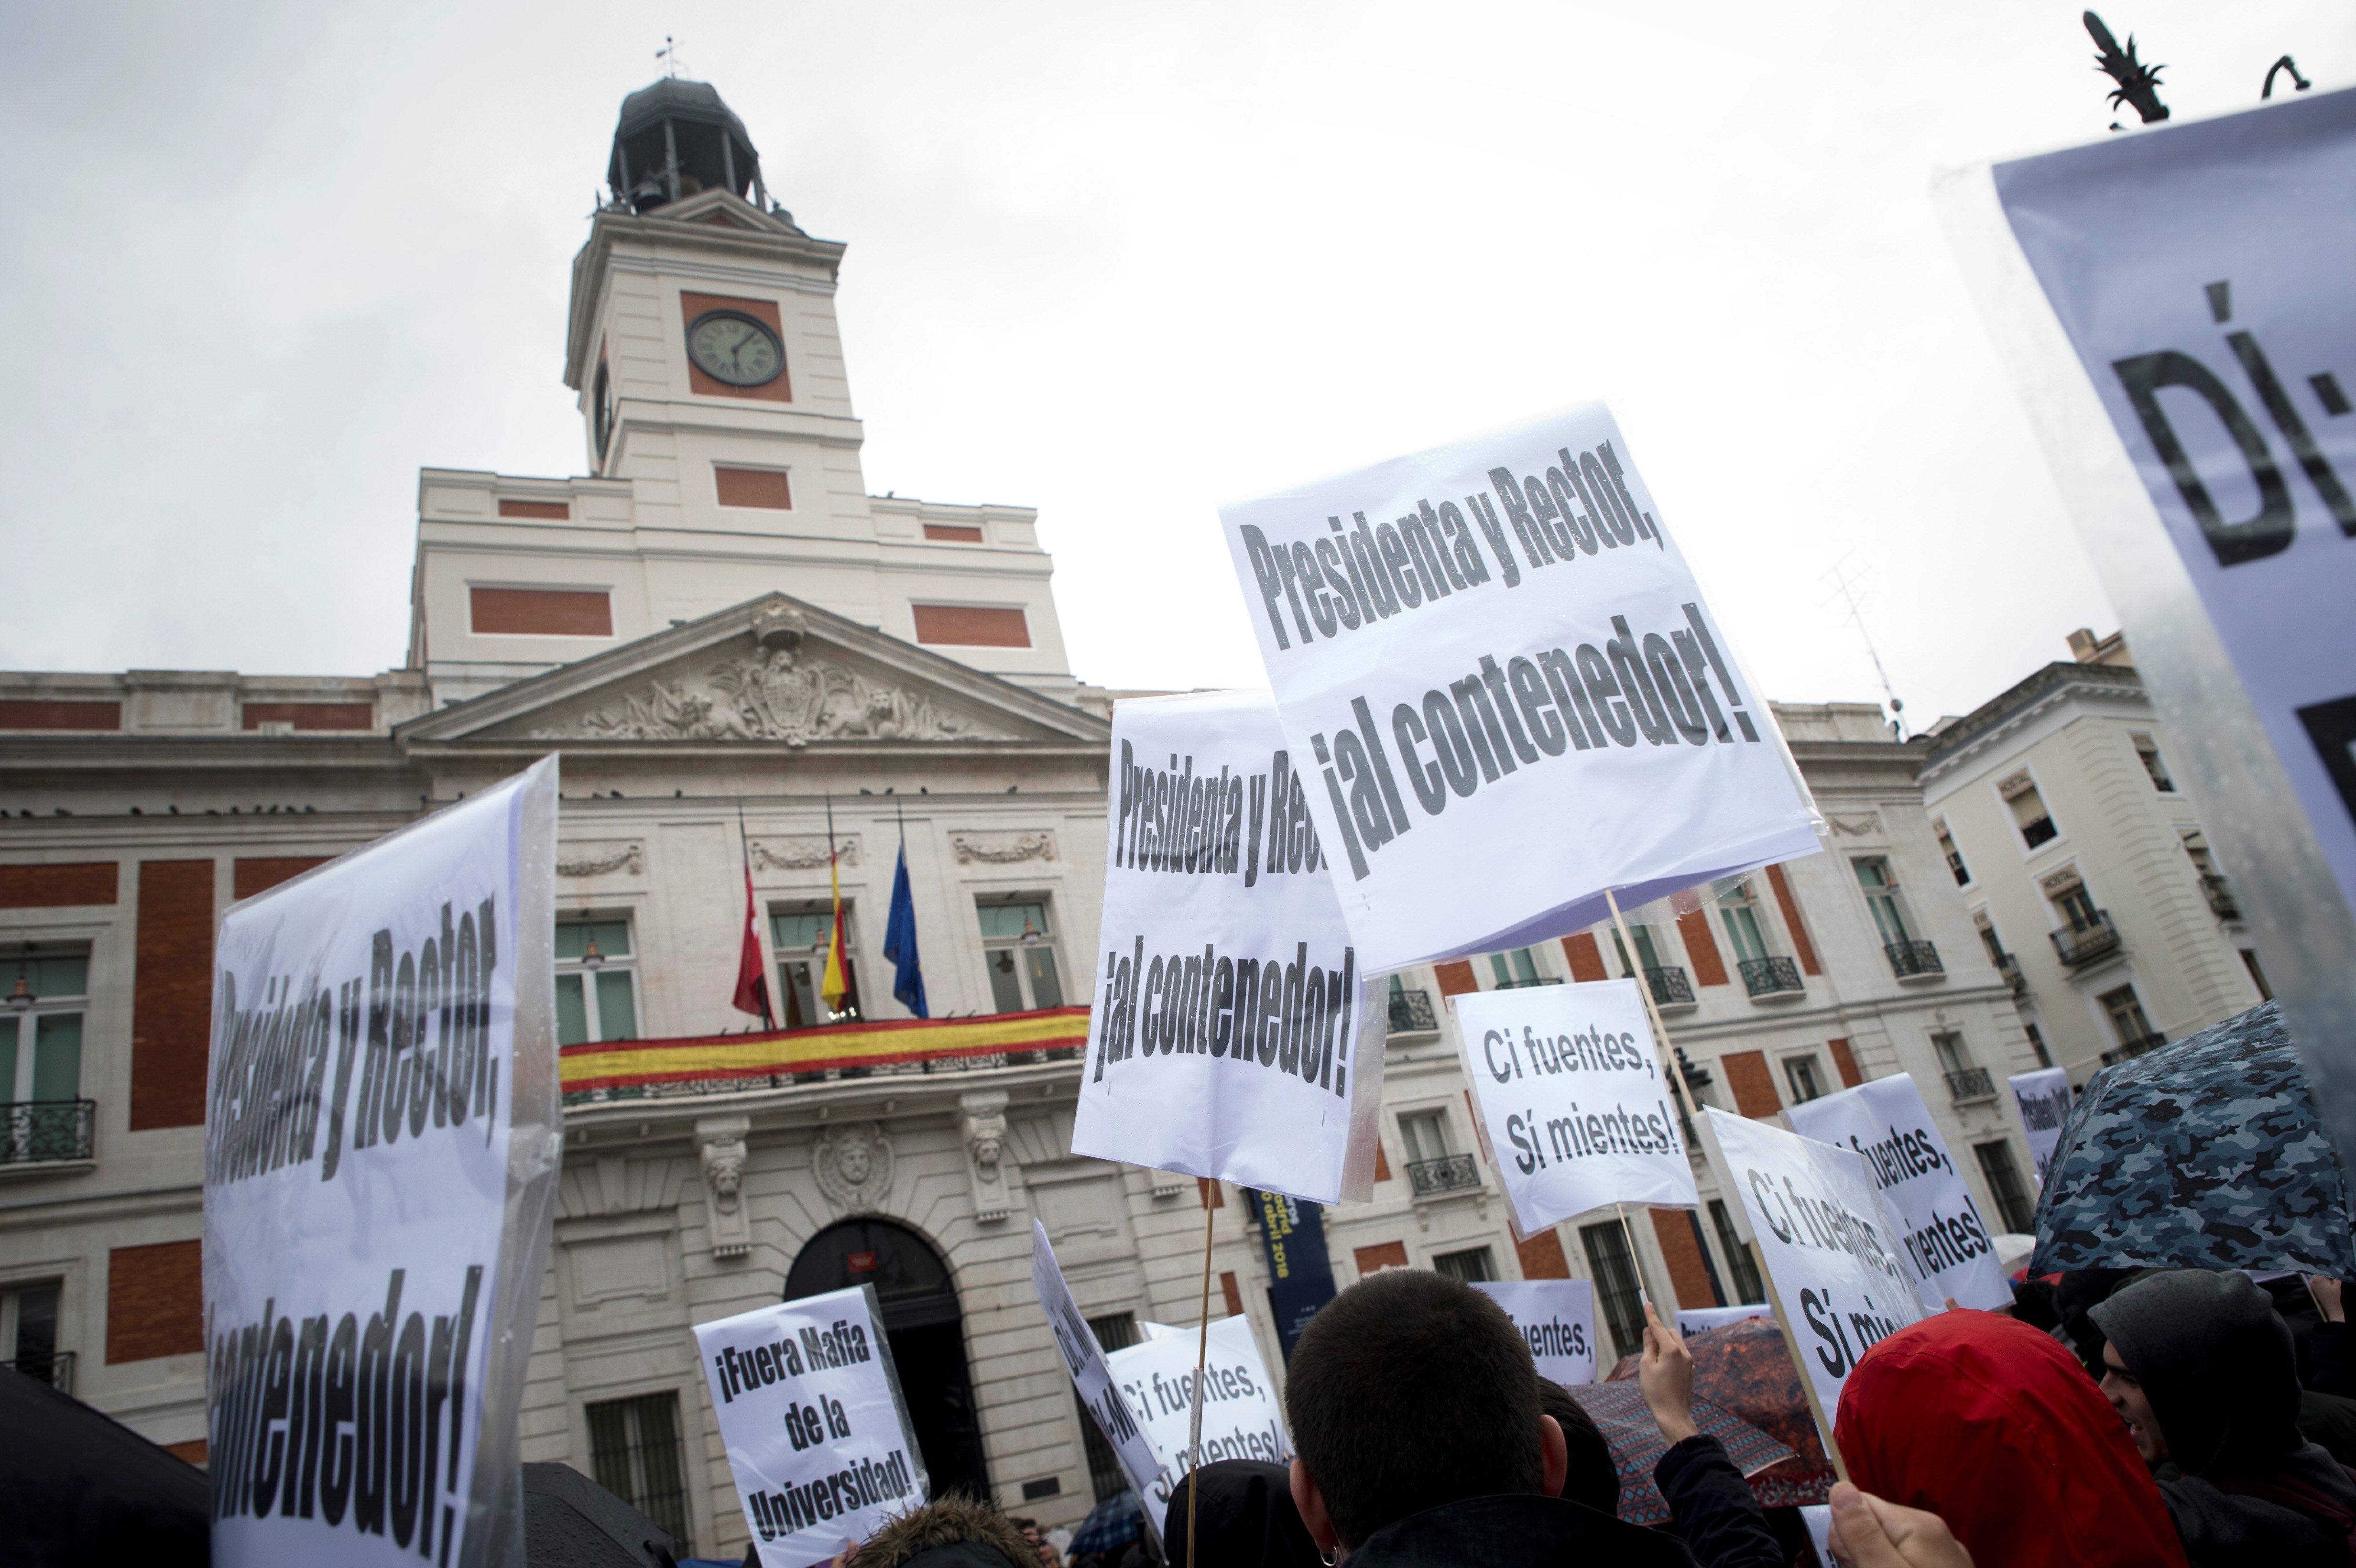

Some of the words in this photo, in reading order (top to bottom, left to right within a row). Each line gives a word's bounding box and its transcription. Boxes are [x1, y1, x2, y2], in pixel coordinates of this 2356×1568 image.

[1464, 492, 1519, 589] y
[1488, 439, 1664, 569] Rector,
[1240, 499, 1491, 651] Presidenta
[1310, 696, 1411, 882] ¡al
[1392, 602, 1760, 815] contenedor!
[1116, 738, 1243, 873] Presidenta
[1245, 774, 1266, 887] y
[1267, 750, 1328, 874] Rec
[1093, 935, 1144, 1083] ¡al
[1141, 942, 1354, 1099] contenedor!
[1484, 1028, 1522, 1083] Ci
[1524, 1023, 1654, 1080] fuentes,
[321, 975, 362, 1182] y
[1506, 1109, 1546, 1175] Sí
[1546, 1100, 1680, 1163] mientes!
[1264, 1204, 1282, 1241] abril
[1748, 1168, 1805, 1244] Ci
[1272, 1242, 1289, 1279] 2018
[715, 1338, 805, 1404] ¡Fuera
[798, 1320, 872, 1372] Mafia
[1800, 1288, 1856, 1379] Sí
[784, 1402, 824, 1451] de
[819, 1394, 851, 1440] la
[1153, 1362, 1265, 1416] fuentes,
[748, 1449, 915, 1542] Universidad!
